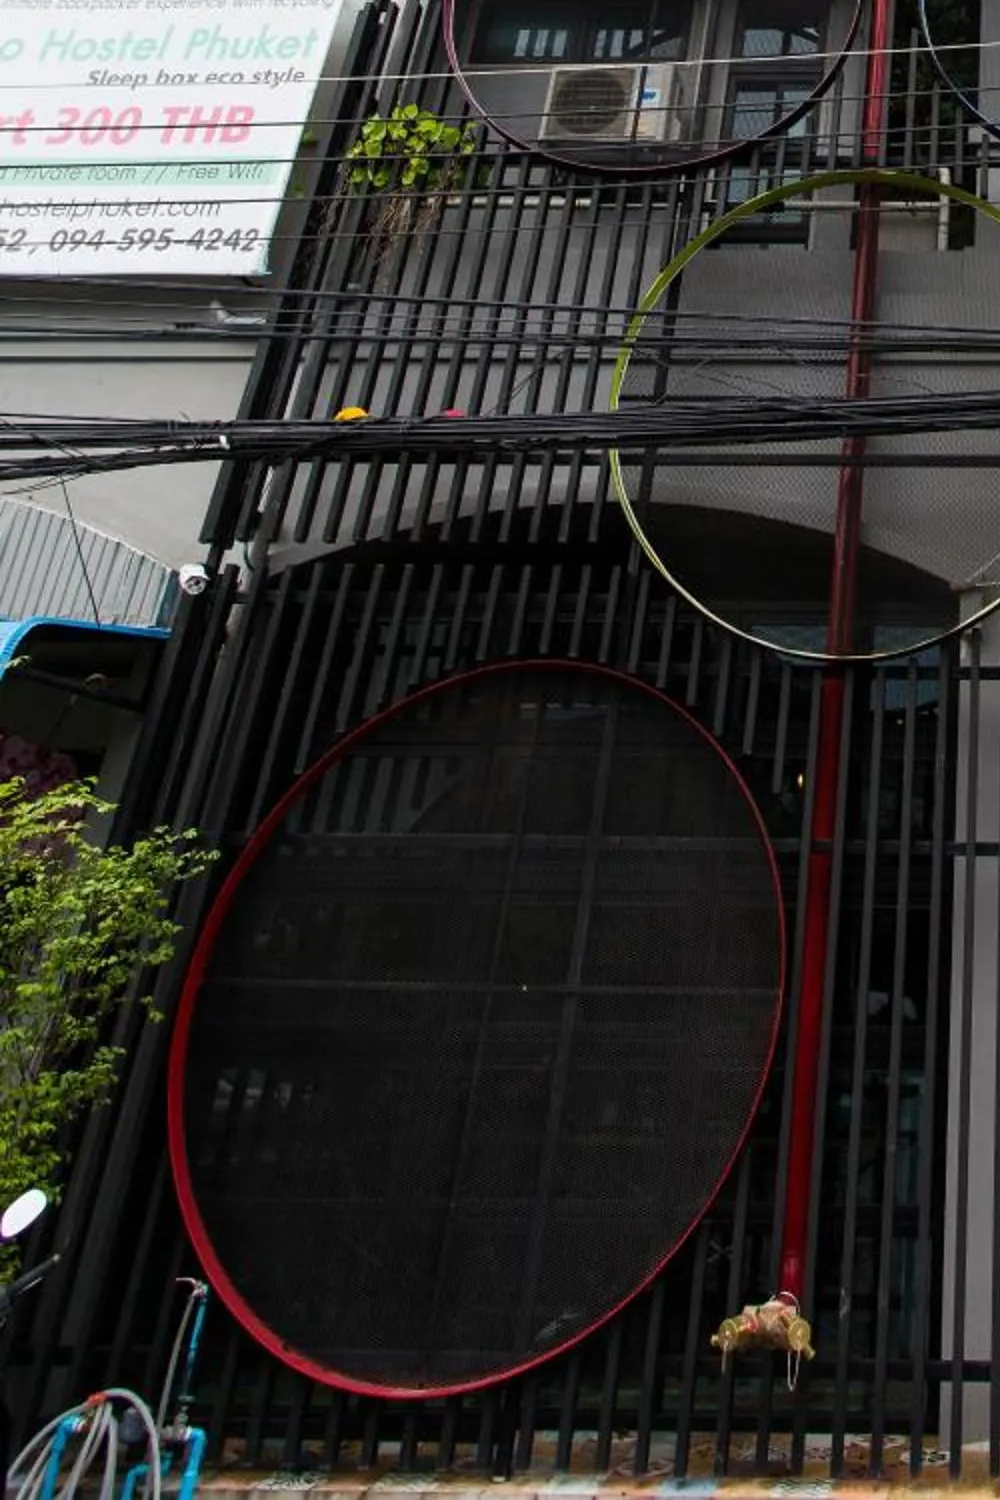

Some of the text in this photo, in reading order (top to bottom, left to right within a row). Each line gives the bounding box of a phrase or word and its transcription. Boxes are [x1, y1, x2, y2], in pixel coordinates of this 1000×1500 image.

[38, 23, 177, 63] Hostel
[183, 22, 319, 61] Phuket
[85, 65, 306, 91] Sleep box eco style
[44, 105, 144, 146] 300
[159, 104, 256, 145] THB
[87, 165, 138, 181] room
[176, 162, 220, 180] Free
[48, 226, 261, 254] 094-595-4242
